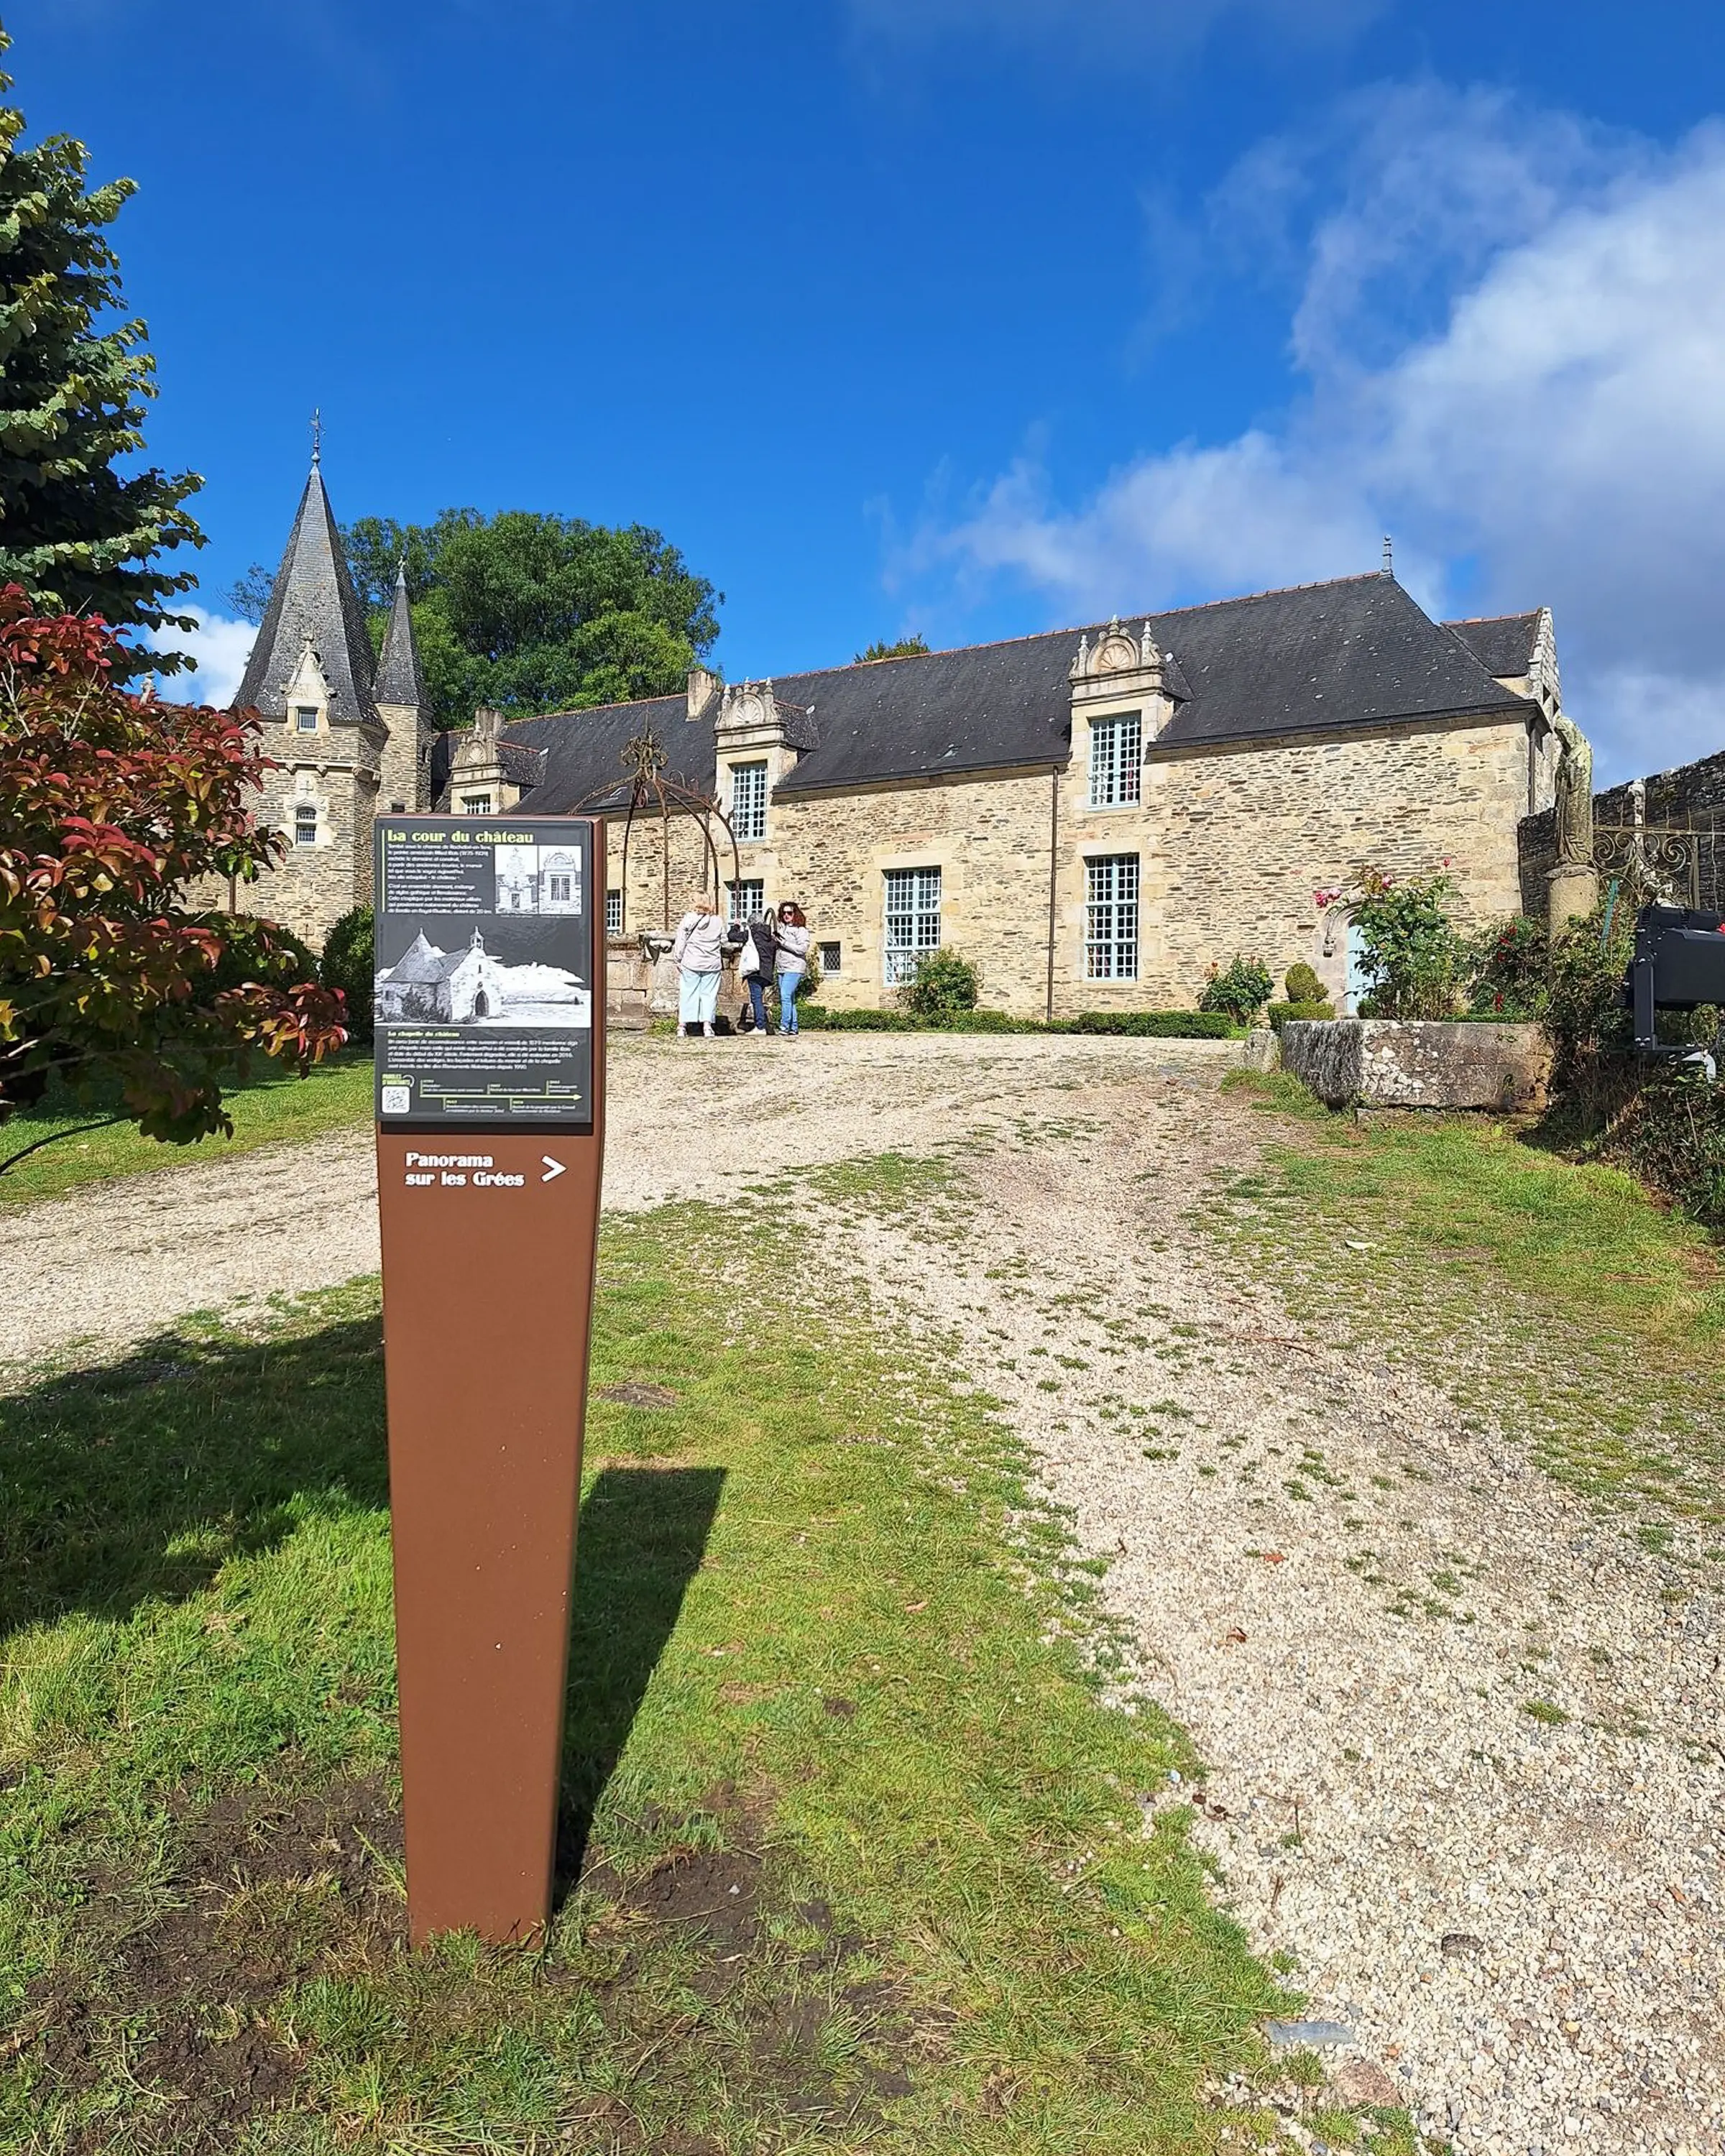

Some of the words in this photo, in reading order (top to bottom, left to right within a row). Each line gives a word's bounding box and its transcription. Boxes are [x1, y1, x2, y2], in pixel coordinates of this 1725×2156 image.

[387, 829, 406, 842] La
[412, 832, 446, 842] cour
[451, 831, 469, 842] du
[475, 831, 534, 843] château
[405, 1153, 493, 1167] Panorama
[405, 1173, 435, 1186] sur
[441, 1171, 466, 1186] les
[474, 1171, 525, 1187] Grées
